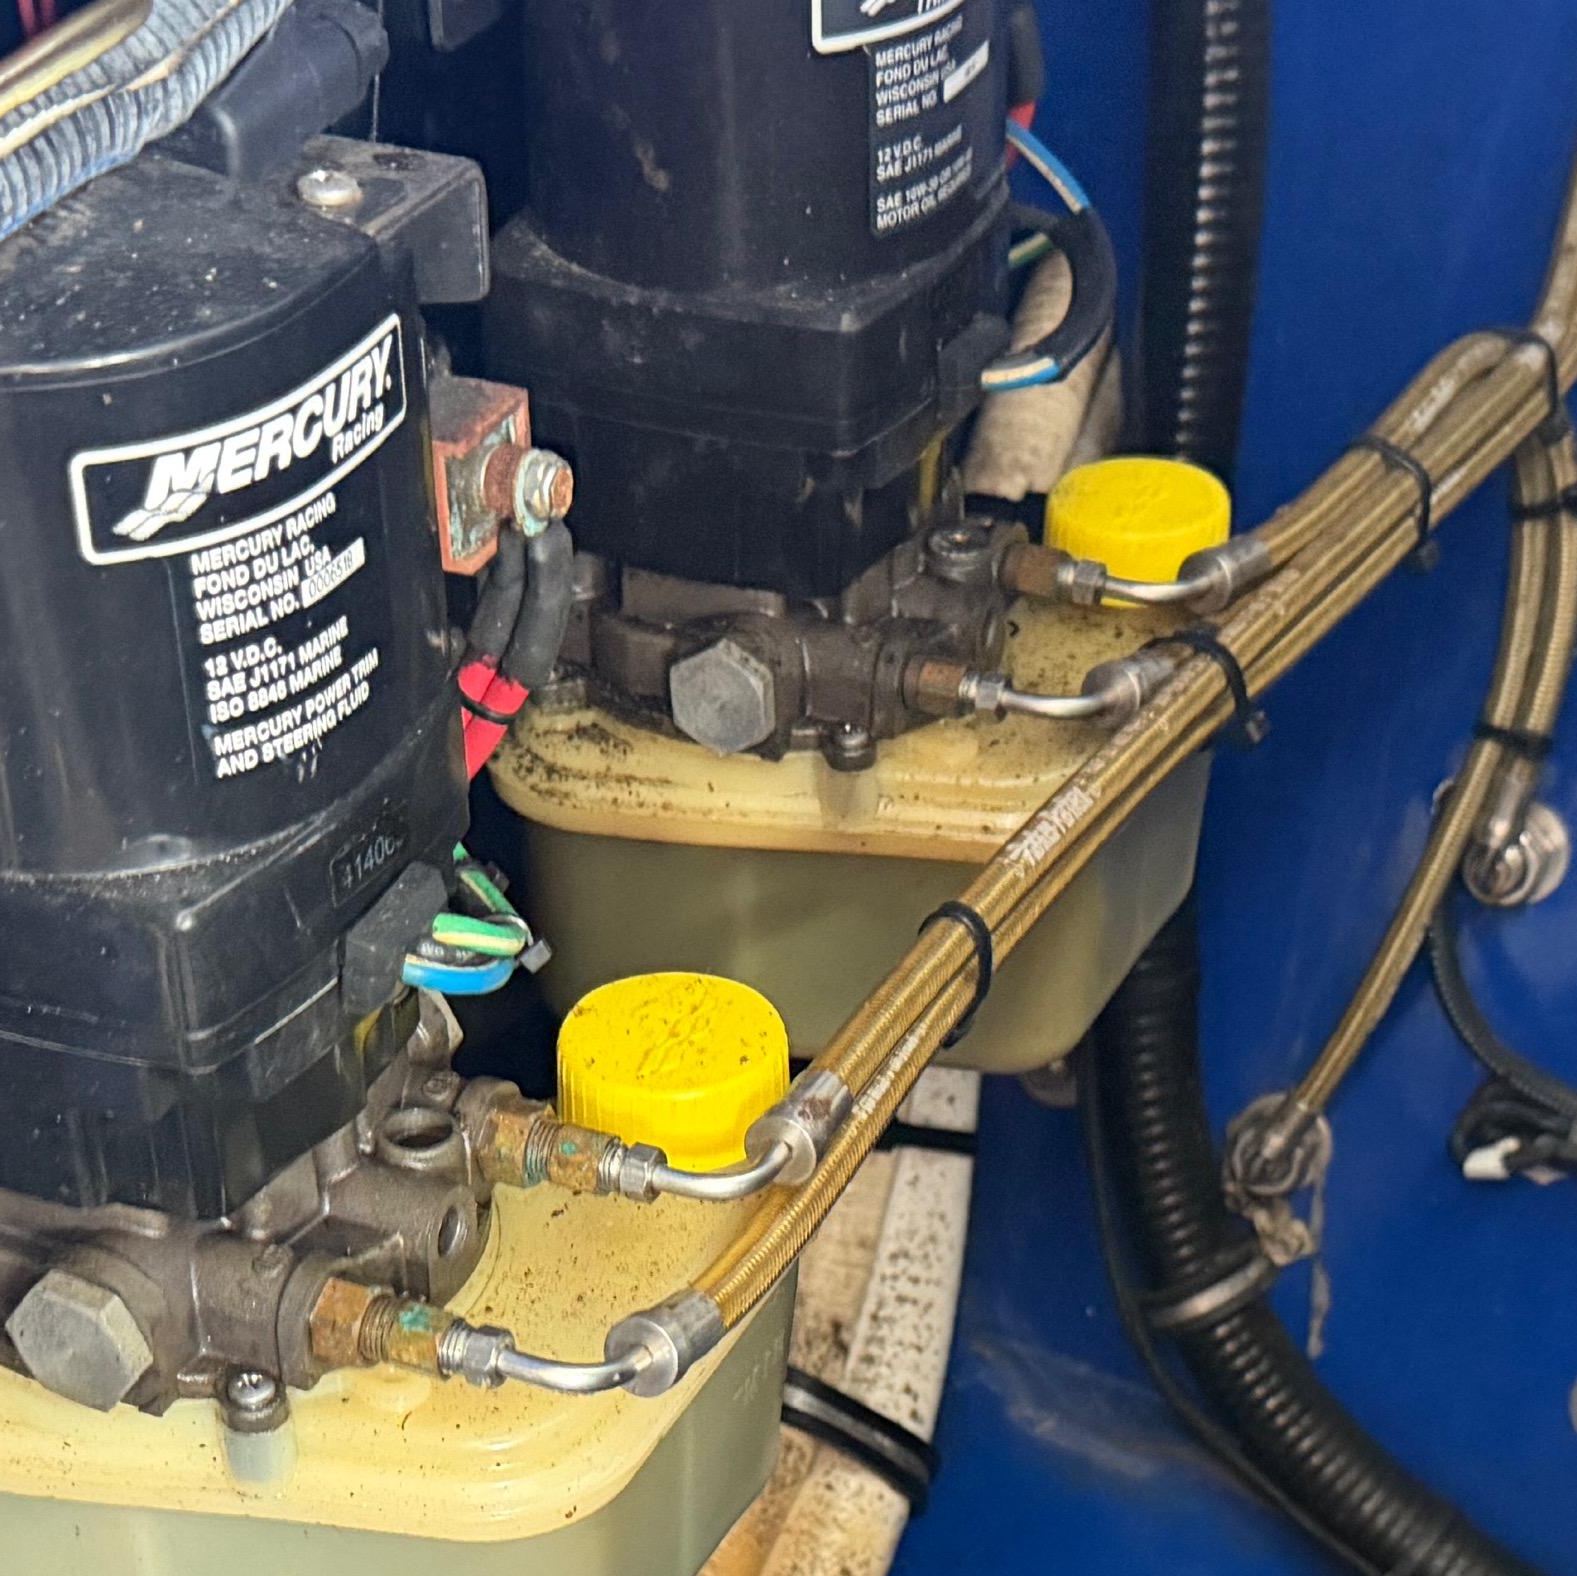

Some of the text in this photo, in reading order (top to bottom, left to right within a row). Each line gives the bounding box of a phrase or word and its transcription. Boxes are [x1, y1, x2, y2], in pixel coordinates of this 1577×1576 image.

[875, 34, 933, 69] MERCURY
[876, 63, 911, 88] FOND
[913, 58, 929, 76] DU
[875, 70, 939, 107] WISCONSIN
[876, 99, 920, 128] SERIAL
[876, 160, 903, 183] SAE
[876, 192, 903, 214] SAE
[876, 202, 920, 231] MOTOR
[144, 334, 392, 509] MERCURY
[331, 402, 386, 466] Racing
[190, 491, 337, 576] MERCURY RACING
[193, 535, 315, 599] FOND DU LAC,
[195, 544, 333, 622] WISCONSIN USA
[199, 609, 270, 645] SERIAL
[270, 592, 300, 622] NO.
[204, 636, 284, 679] 12 V.D.C.
[206, 614, 350, 702] SAE J1171 MARINE
[209, 696, 245, 724] ISO
[288, 645, 343, 695] MARINE
[213, 647, 380, 757] MERCURY POWER TRIM
[216, 680, 371, 779] AND STEERING FLUID
